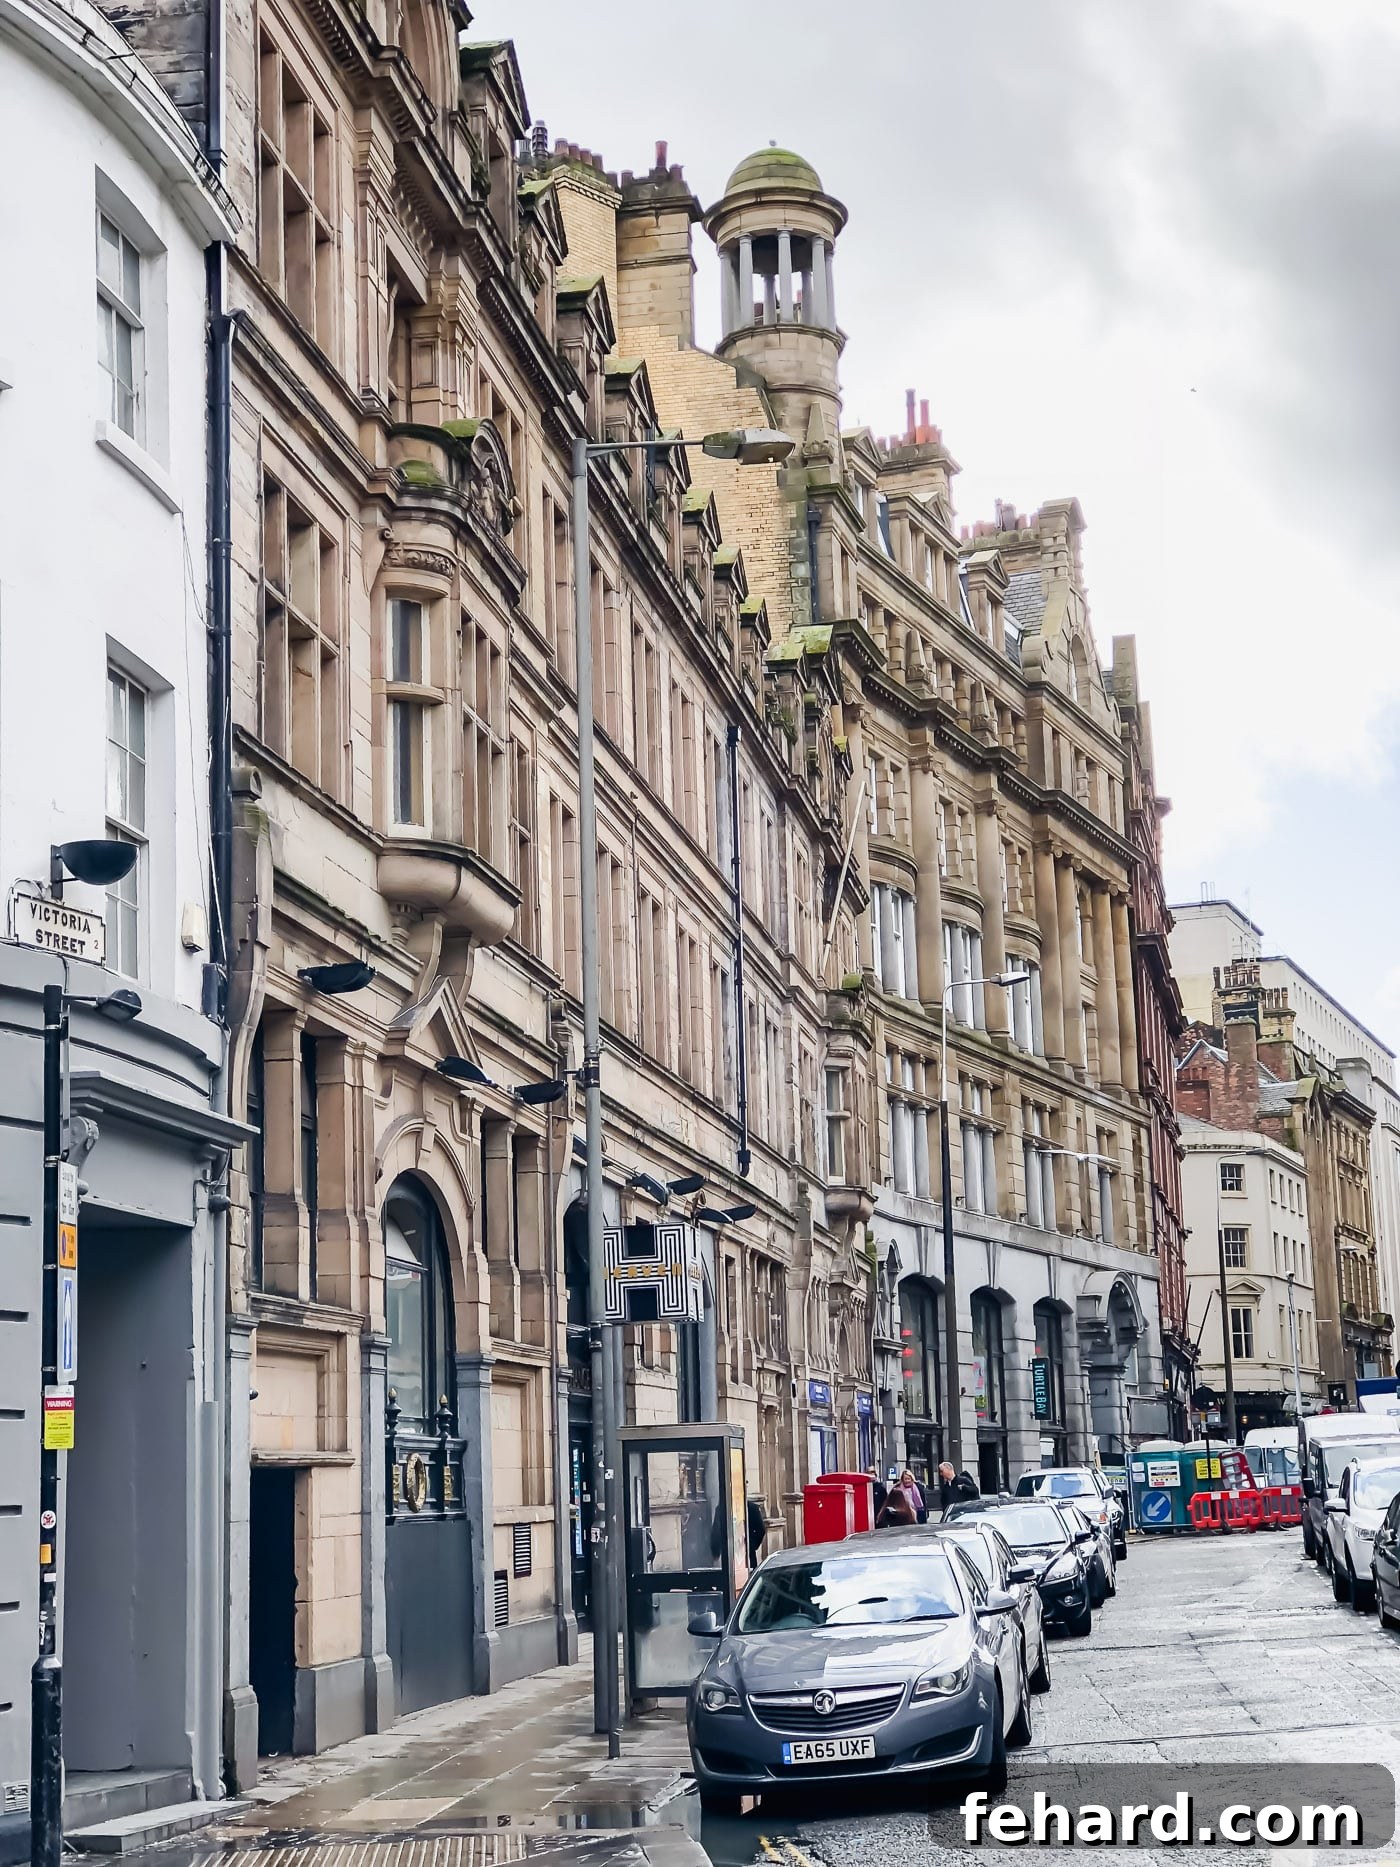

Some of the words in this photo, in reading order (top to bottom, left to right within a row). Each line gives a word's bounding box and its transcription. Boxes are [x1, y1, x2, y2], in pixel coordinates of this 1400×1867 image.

[30, 902, 91, 934] VICTORIA
[35, 928, 86, 955] STREET
[47, 1399, 72, 1408] WARNING
[793, 1742, 835, 1760] EA65
[839, 1739, 870, 1756] UXF
